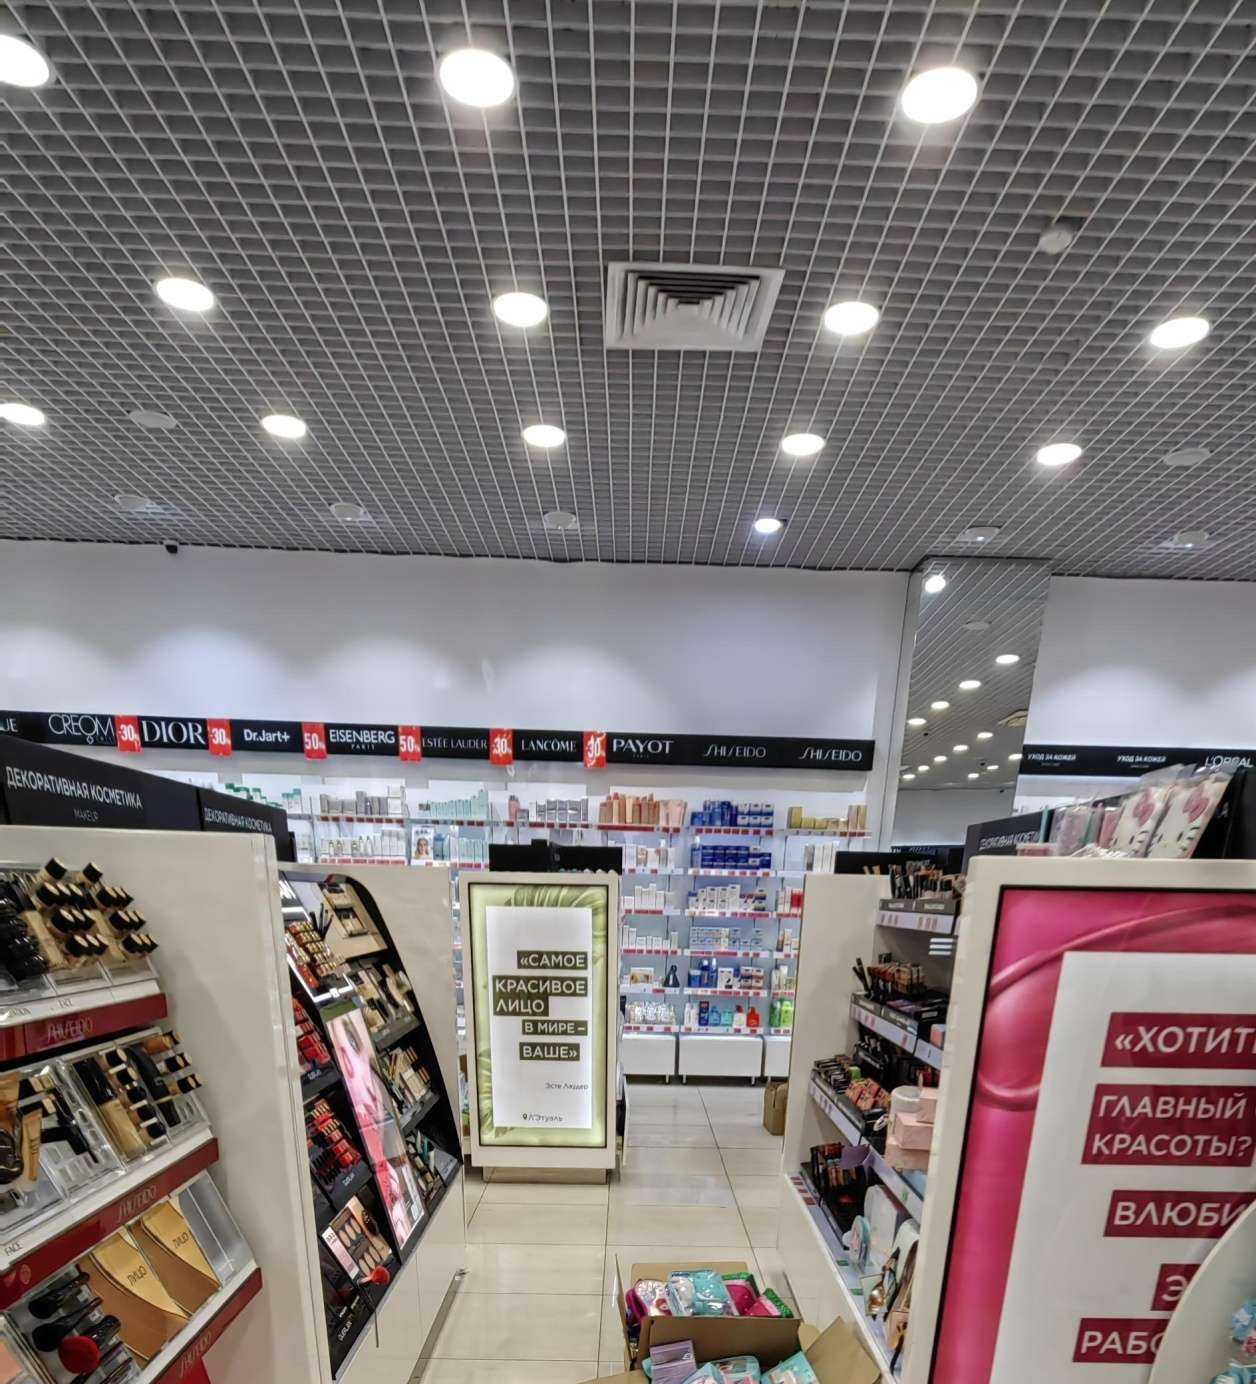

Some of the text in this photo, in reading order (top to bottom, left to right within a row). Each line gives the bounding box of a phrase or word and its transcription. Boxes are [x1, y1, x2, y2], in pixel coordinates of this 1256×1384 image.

[142, 720, 206, 745] DIOR
[243, 729, 291, 743] Dr.Jart+
[329, 729, 396, 744] EISENBERG
[450, 738, 488, 750] LAUDER
[612, 739, 674, 754] PAYOT
[703, 744, 767, 759] SHISEIDO
[798, 746, 863, 762] SHISEIDO
[6, 766, 143, 810] ДЕКОРАТИВНАЯ КОСМЕТИКА
[520, 953, 586, 968] «САМОЕ
[495, 979, 586, 994] КРАСИВОЕ
[496, 999, 545, 1014] ЛИЦО
[524, 1022, 534, 1033] В
[538, 1022, 576, 1034] МИРЕ
[523, 1046, 578, 1059] ВАШЕ»
[1098, 1092, 1248, 1120] ГЛАВНЫЙ
[1091, 1133, 1252, 1157] КРАСОТЫ?
